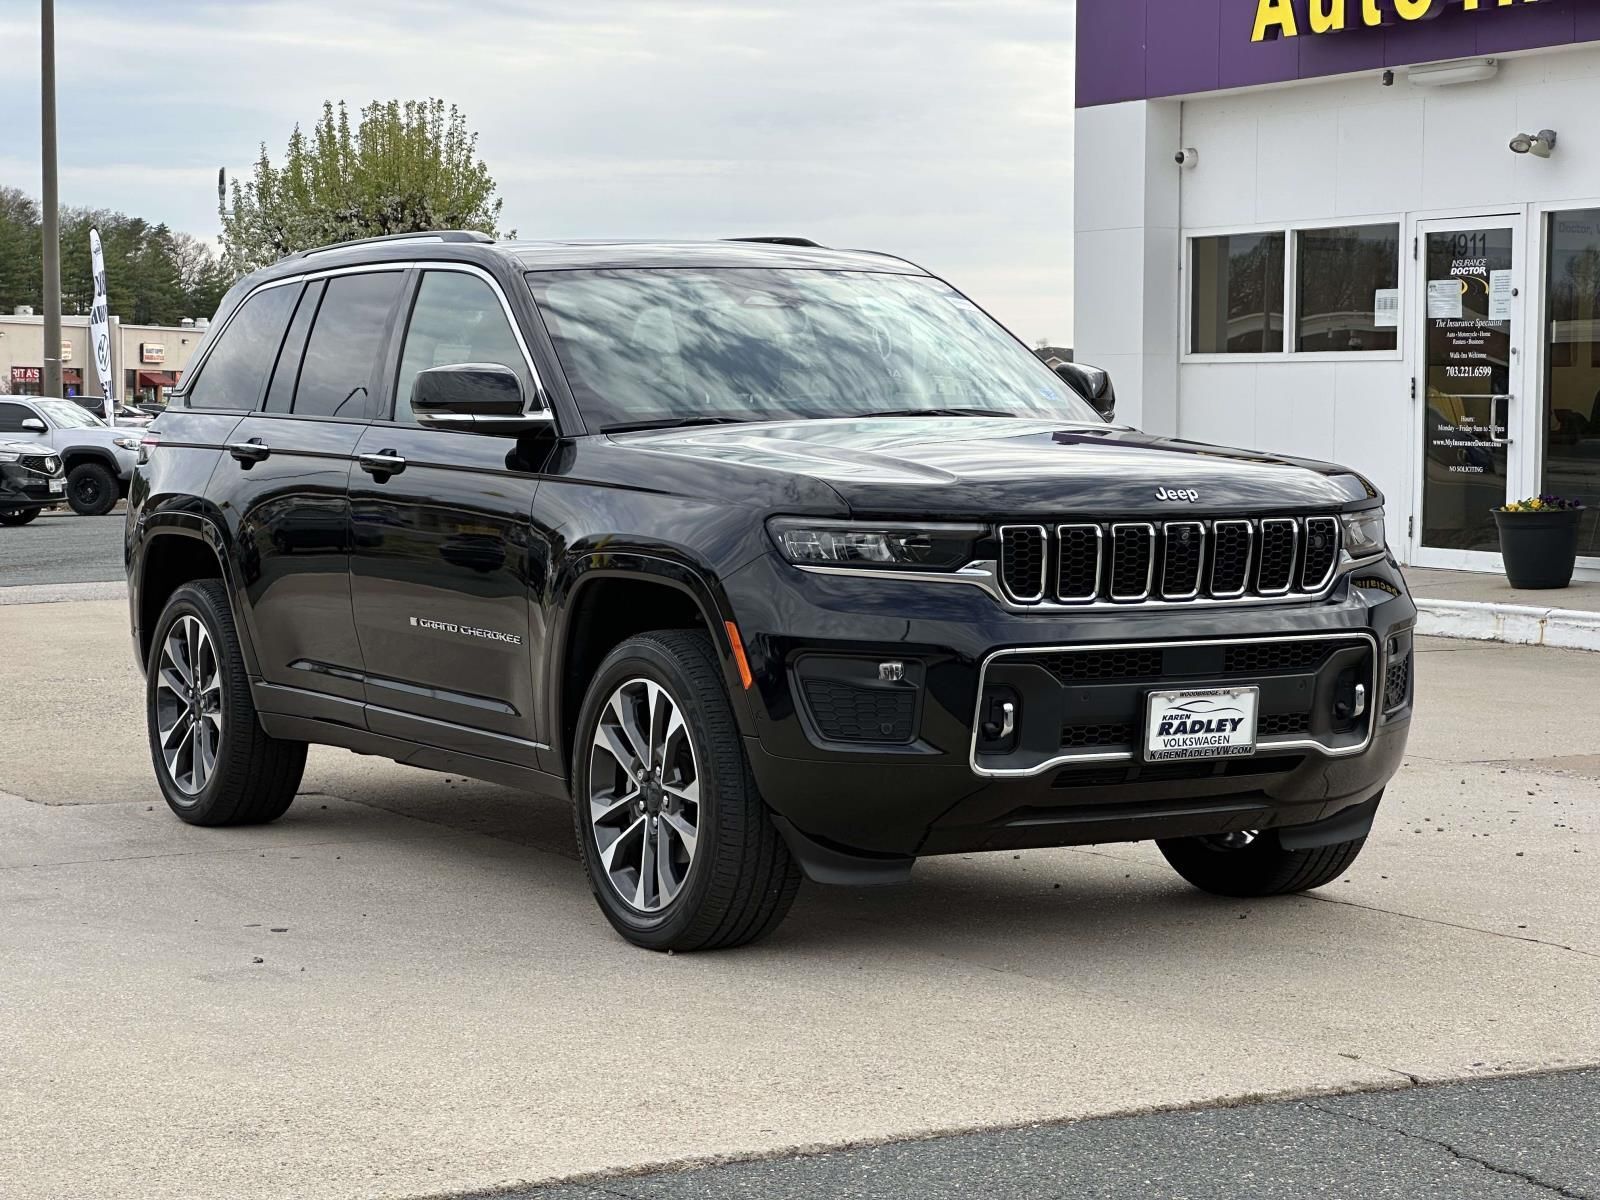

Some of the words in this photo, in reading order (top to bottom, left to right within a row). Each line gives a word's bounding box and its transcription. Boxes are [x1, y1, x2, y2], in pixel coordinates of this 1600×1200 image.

[1449, 232, 1486, 257] 1911
[1451, 258, 1487, 267] INSURANCE
[1450, 266, 1487, 276] DOCTOR
[1435, 319, 1447, 328] The
[1447, 319, 1474, 328] Insurance
[1475, 318, 1502, 329] Specialist
[1468, 351, 1487, 359] Welcome
[12, 368, 40, 378] RITA'S
[1446, 366, 1492, 377] 703.221.6599
[1438, 424, 1455, 432] Monday
[1459, 425, 1473, 433] Friday
[1457, 465, 1484, 473] SOLICITING
[1155, 486, 1199, 503] Jeep
[419, 618, 459, 633] GRAND
[459, 625, 522, 645] CHEROKEE
[1161, 713, 1192, 722] KAREN
[1156, 717, 1245, 738] RADLEY
[1162, 735, 1231, 748] VOLKSWAGEN
